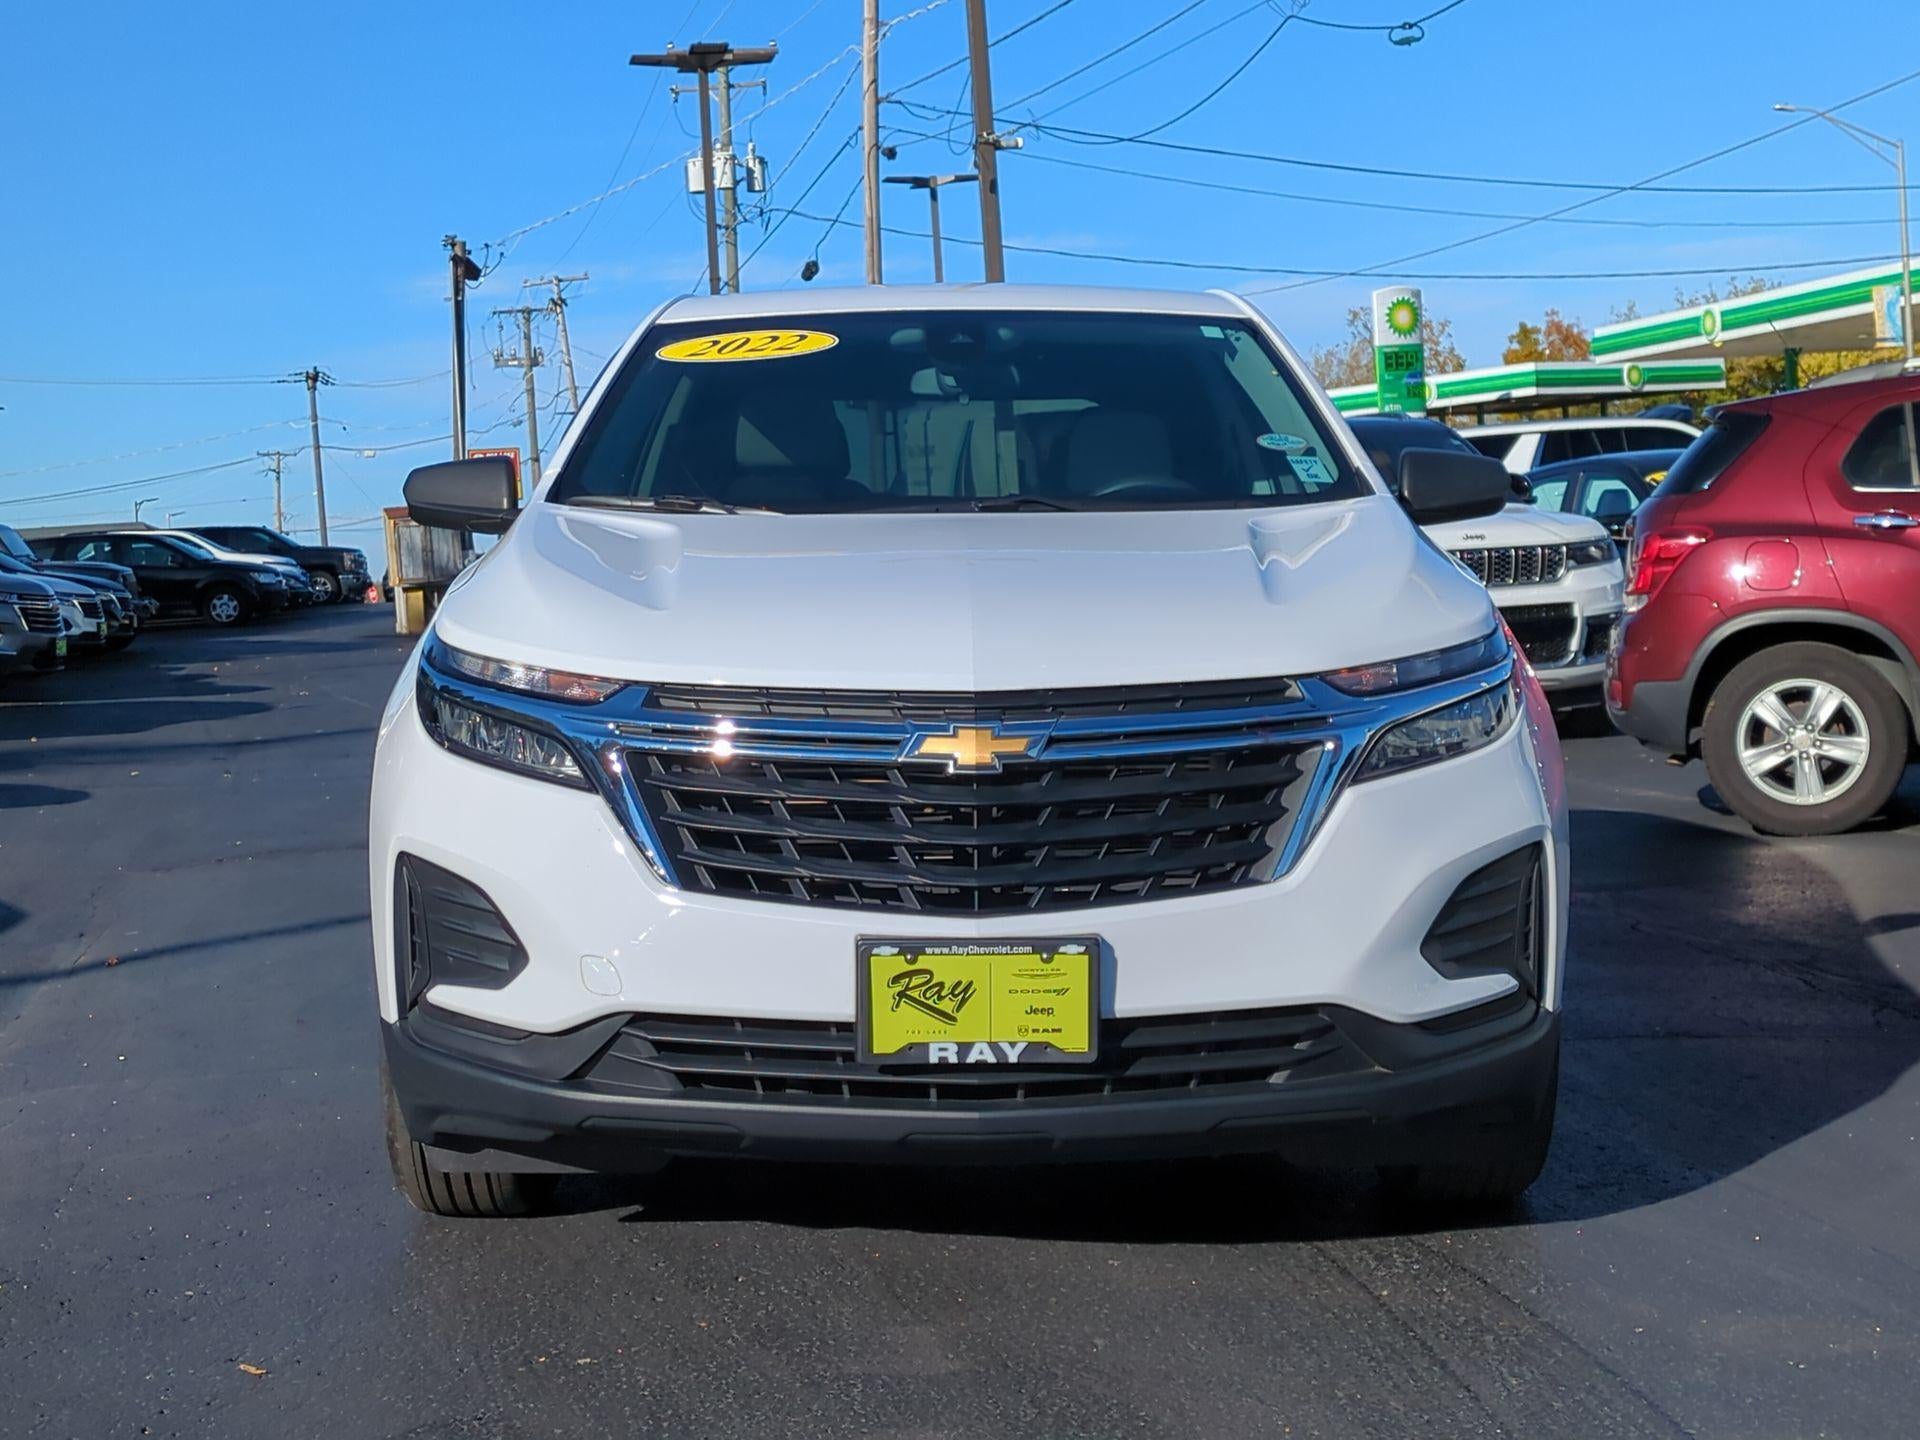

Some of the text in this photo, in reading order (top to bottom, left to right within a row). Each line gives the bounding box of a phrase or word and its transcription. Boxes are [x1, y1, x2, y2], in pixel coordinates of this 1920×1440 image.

[683, 333, 809, 358] 2022
[1462, 533, 1486, 541] Jeep
[924, 945, 1034, 955] www.RayChevrolet.com
[887, 967, 978, 1026] Ray
[1025, 1004, 1055, 1017] Jeep
[928, 1042, 1029, 1064] RAY
